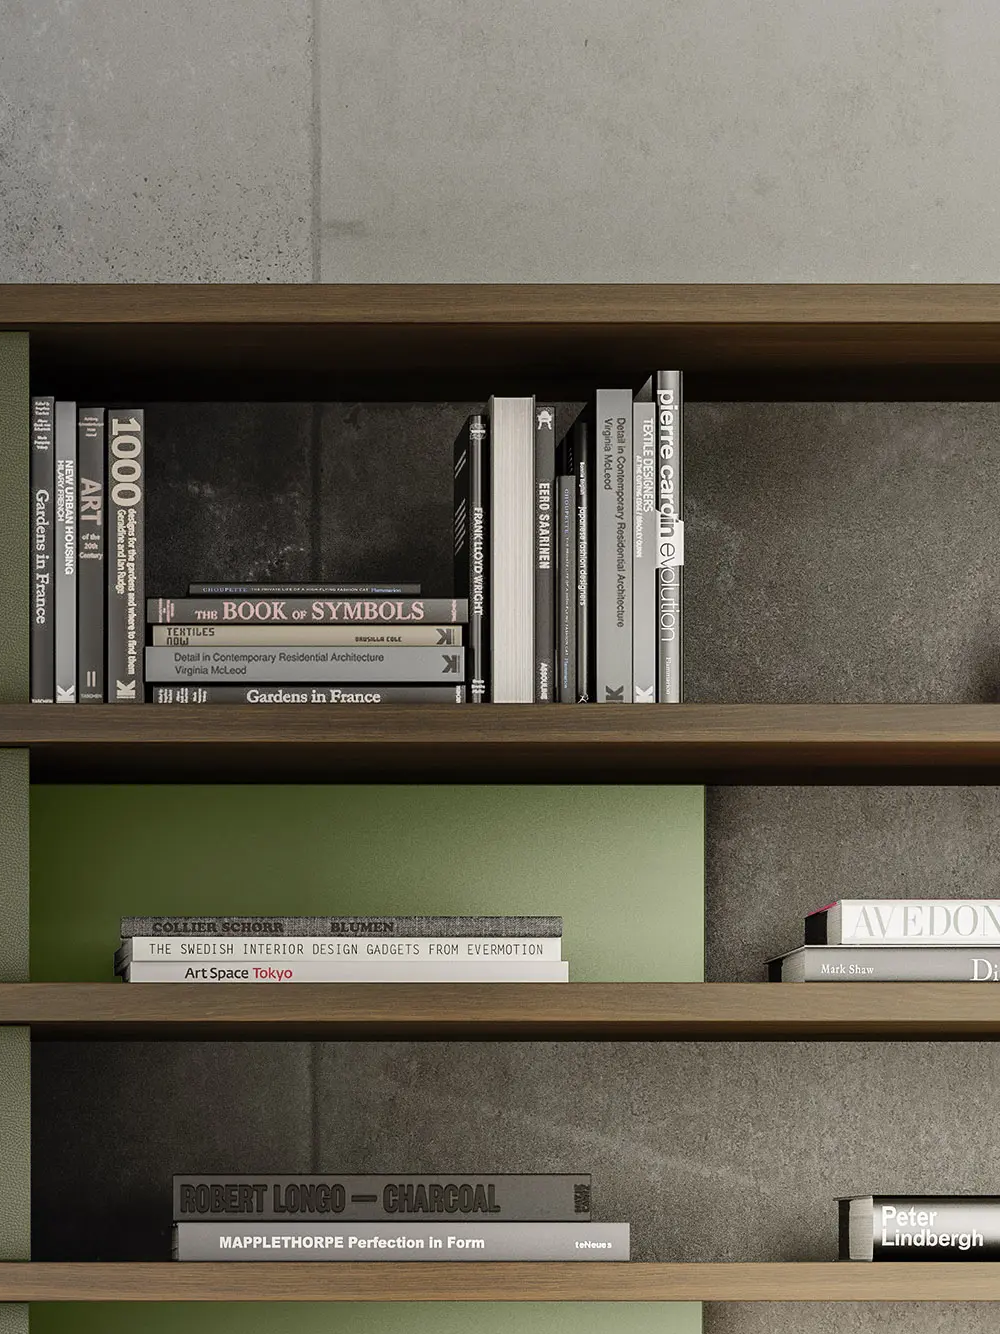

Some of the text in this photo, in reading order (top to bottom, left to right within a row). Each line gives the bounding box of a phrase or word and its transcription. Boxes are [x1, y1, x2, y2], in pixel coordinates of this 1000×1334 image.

[111, 417, 142, 506] 1000
[81, 477, 102, 525] ART
[65, 460, 74, 575] NEW URBAN HOUSING
[657, 389, 679, 641] pierre cardin evolution
[538, 483, 550, 569] EERO SAARINEN
[36, 489, 49, 624] Gardens in France
[115, 509, 126, 595] Geraldine and Ian Rudge
[125, 508, 136, 675] designs for the gardens and where to find them
[195, 601, 424, 620] THE BOOK OF SYMBOLS
[167, 628, 215, 636] TEXTILES
[174, 653, 384, 663] Detail in Contemporary Residential Architecture
[175, 666, 247, 676] Virginia McLeod
[152, 922, 284, 933] COLLIER SCHORR
[330, 922, 394, 933] BLUMEN
[149, 943, 544, 955] THE SWEDISH INTERIOR DESIGN GADGETS FROM EVERMOTION
[185, 967, 293, 981] Art Space Tokyo
[821, 964, 874, 974] Mark Shaw
[970, 959, 999, 981] Di
[179, 1184, 500, 1213] ROBERT LONGO CHARCOAL
[882, 1206, 937, 1226] Peter
[219, 1236, 485, 1249] MAPPLETHORPE Perfection in Form
[882, 1229, 983, 1250] Lindbergh
